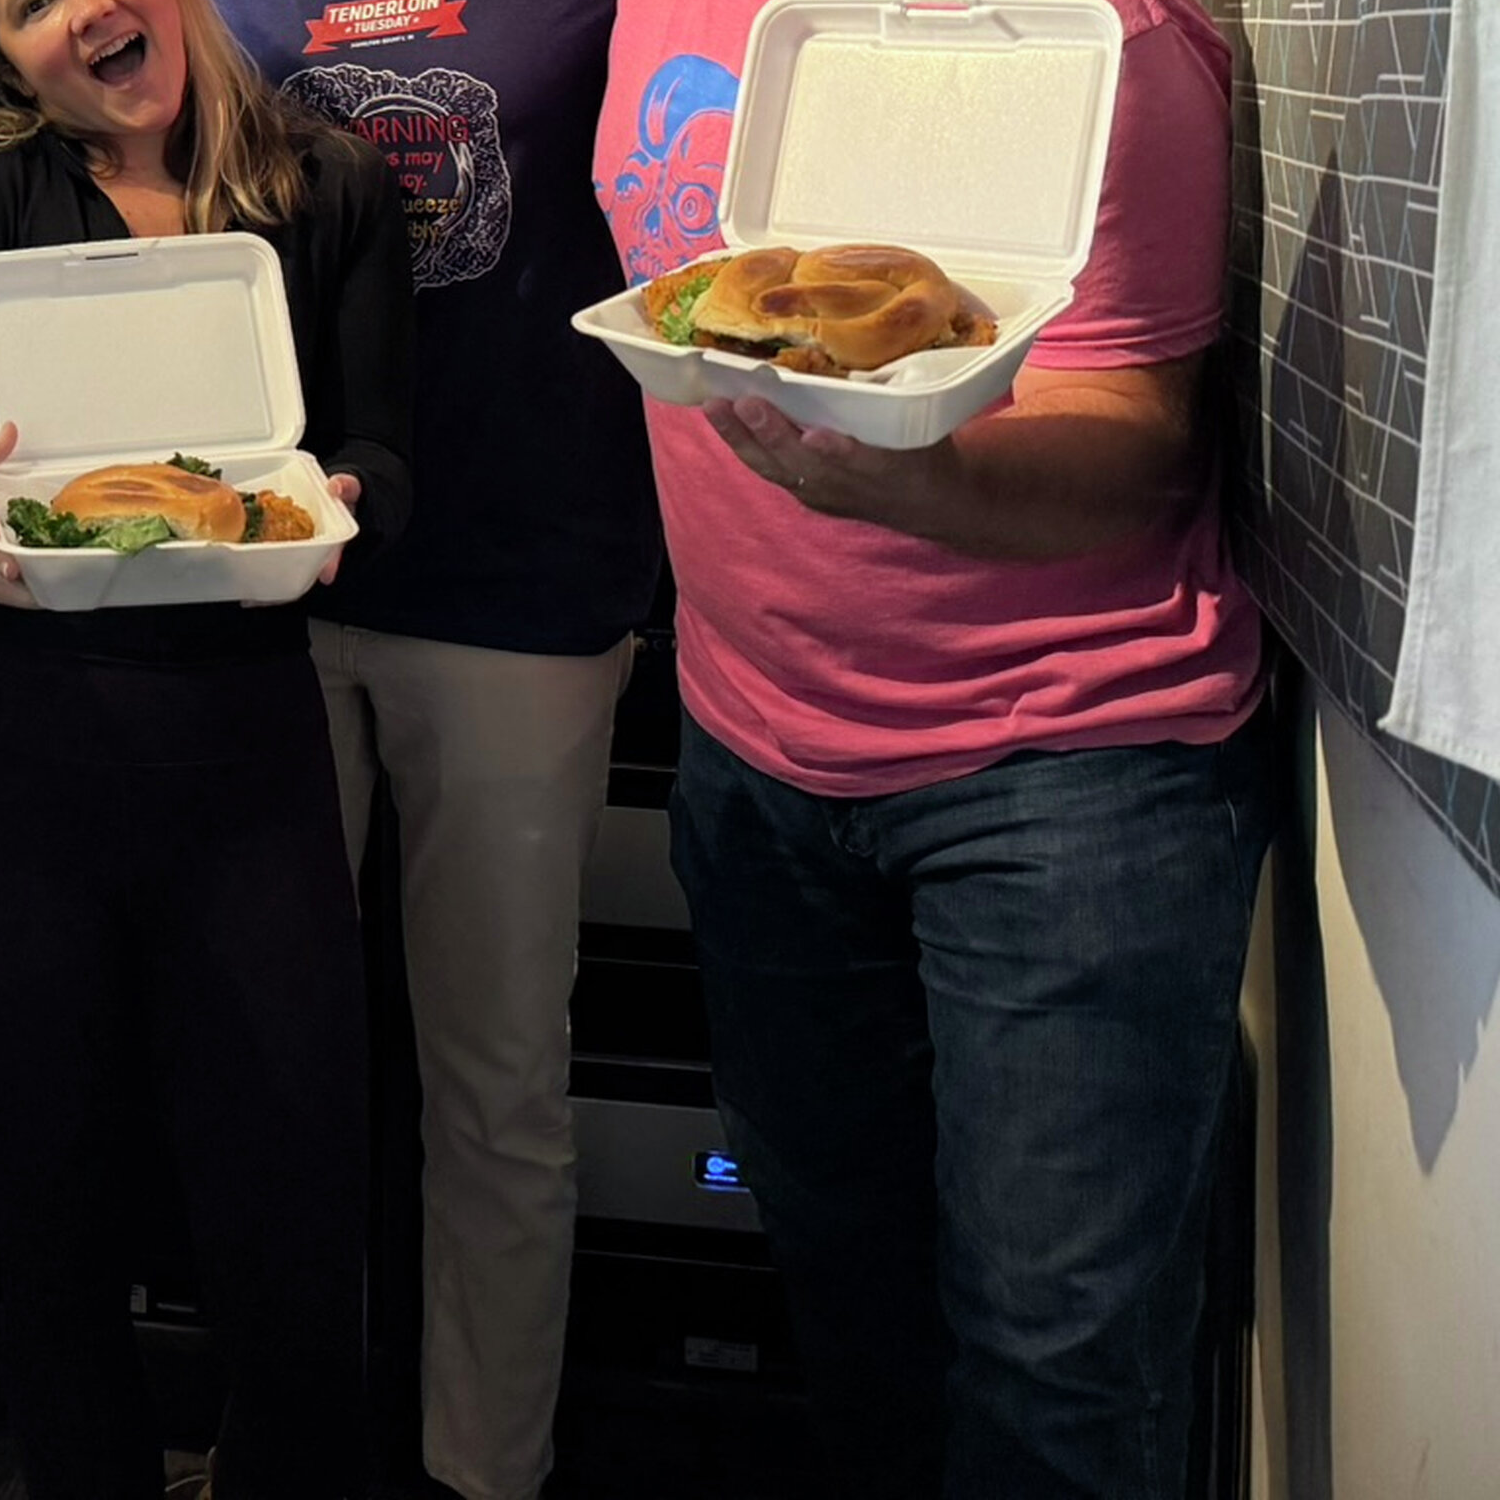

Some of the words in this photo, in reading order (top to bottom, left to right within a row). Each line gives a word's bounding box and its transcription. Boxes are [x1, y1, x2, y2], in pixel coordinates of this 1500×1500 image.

[354, 15, 412, 34] TUESDAY
[405, 152, 445, 174] may
[402, 198, 462, 214] ueeze
